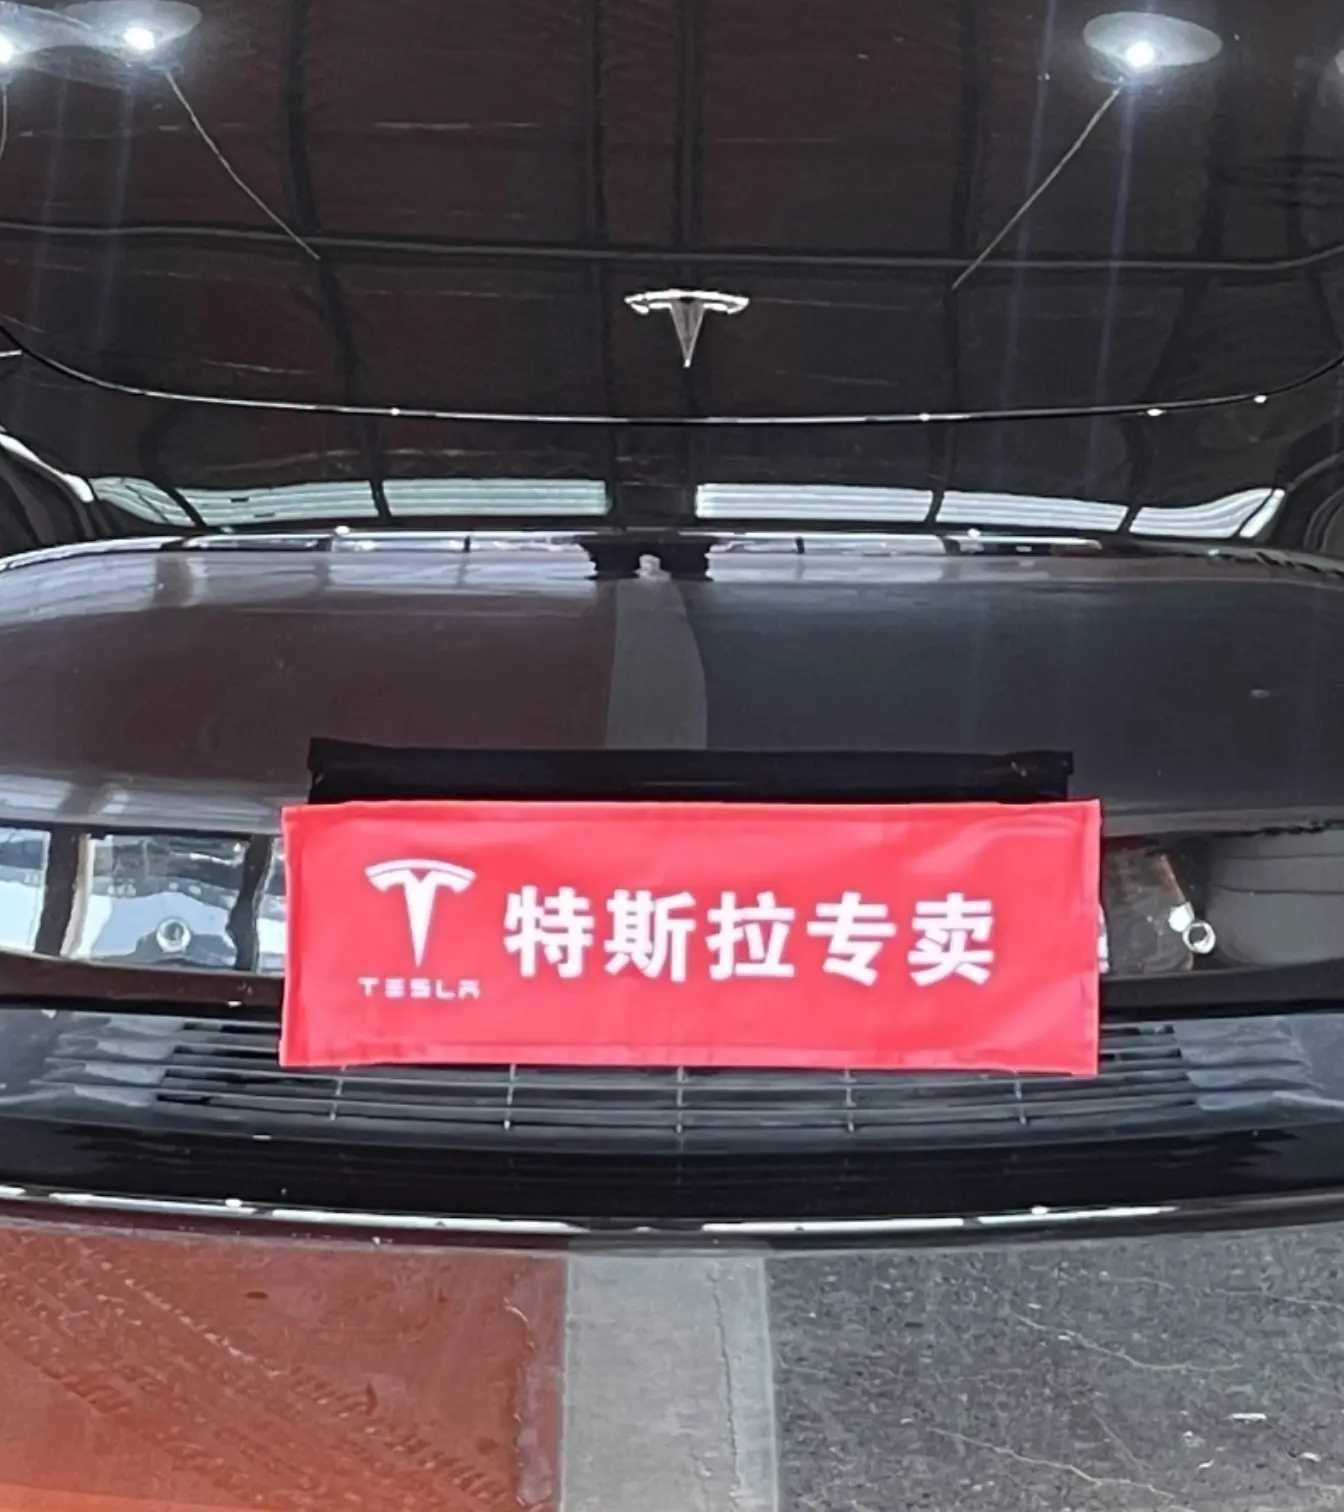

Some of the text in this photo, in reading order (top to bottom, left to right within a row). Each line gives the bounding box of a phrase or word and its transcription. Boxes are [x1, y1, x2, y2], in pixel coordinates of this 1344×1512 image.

[503, 886, 995, 986] 特斯拉专卖
[358, 977, 481, 1000] TESLA
